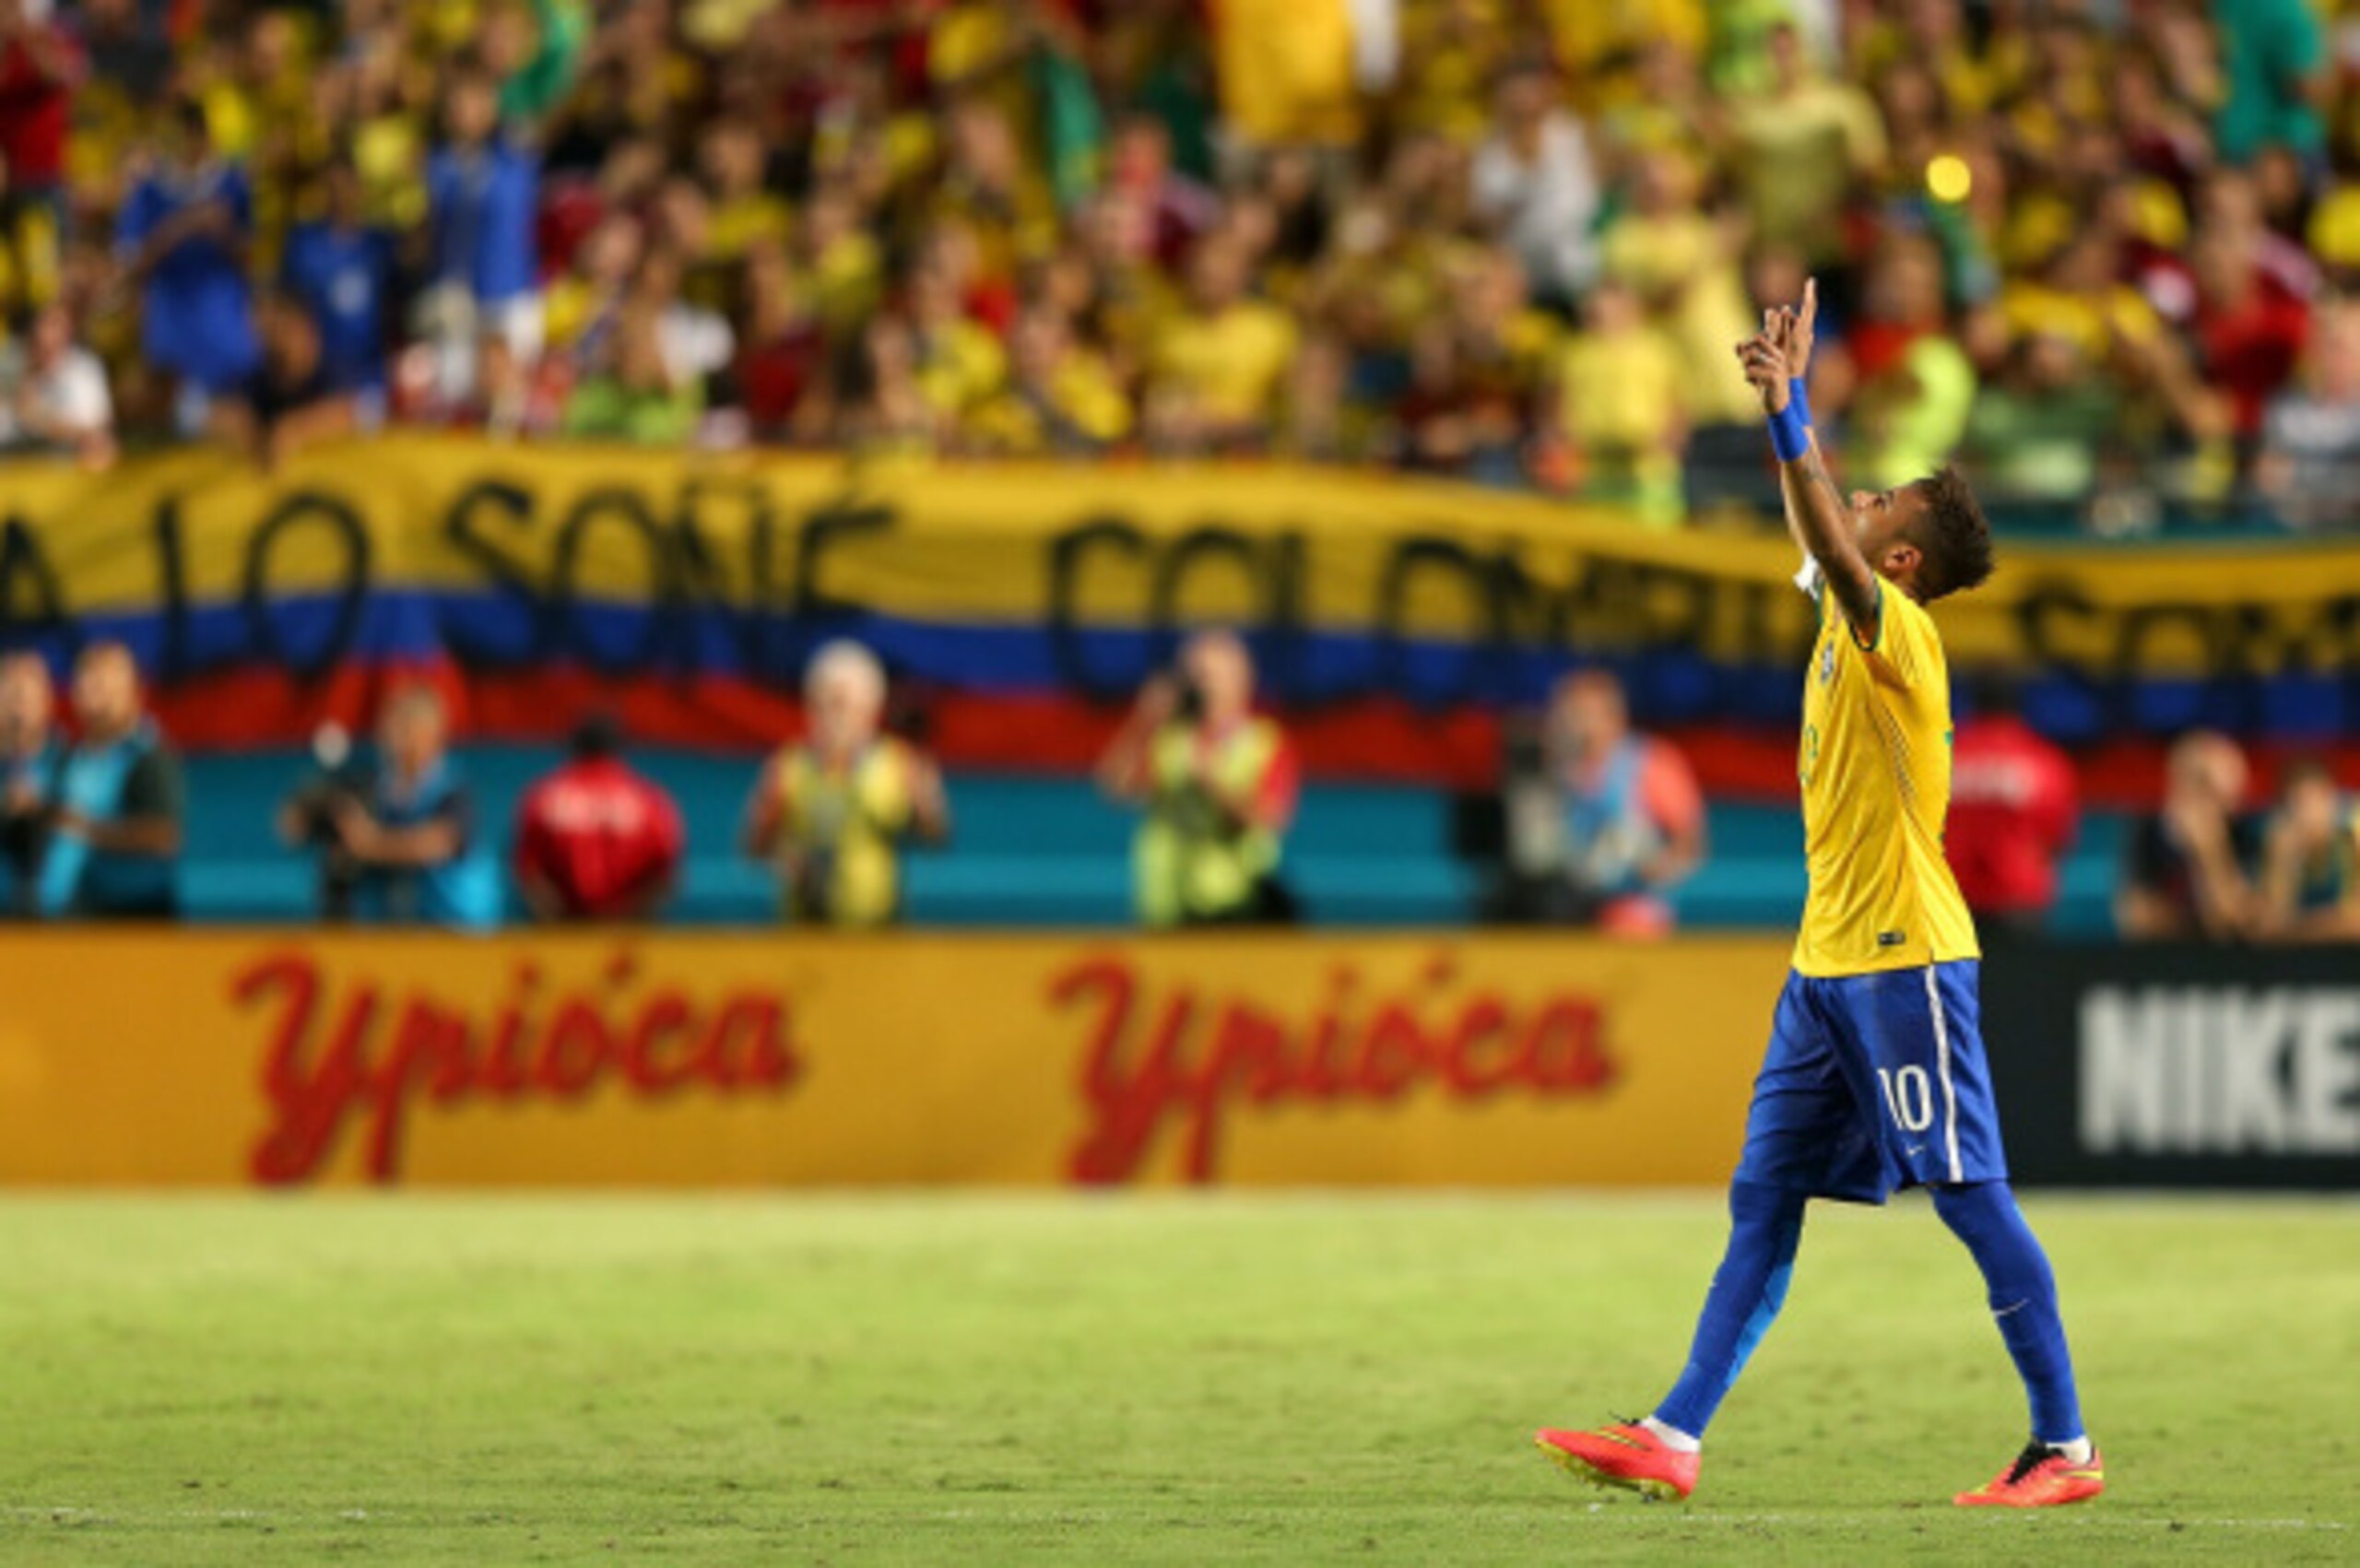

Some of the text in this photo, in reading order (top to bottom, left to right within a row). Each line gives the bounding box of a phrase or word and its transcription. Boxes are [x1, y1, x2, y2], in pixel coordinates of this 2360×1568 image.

[230, 940, 806, 1187] Ypióca
[1045, 942, 1624, 1187] Ypióca
[1877, 1065, 1933, 1131] 10
[2078, 983, 2360, 1154] NIKE
